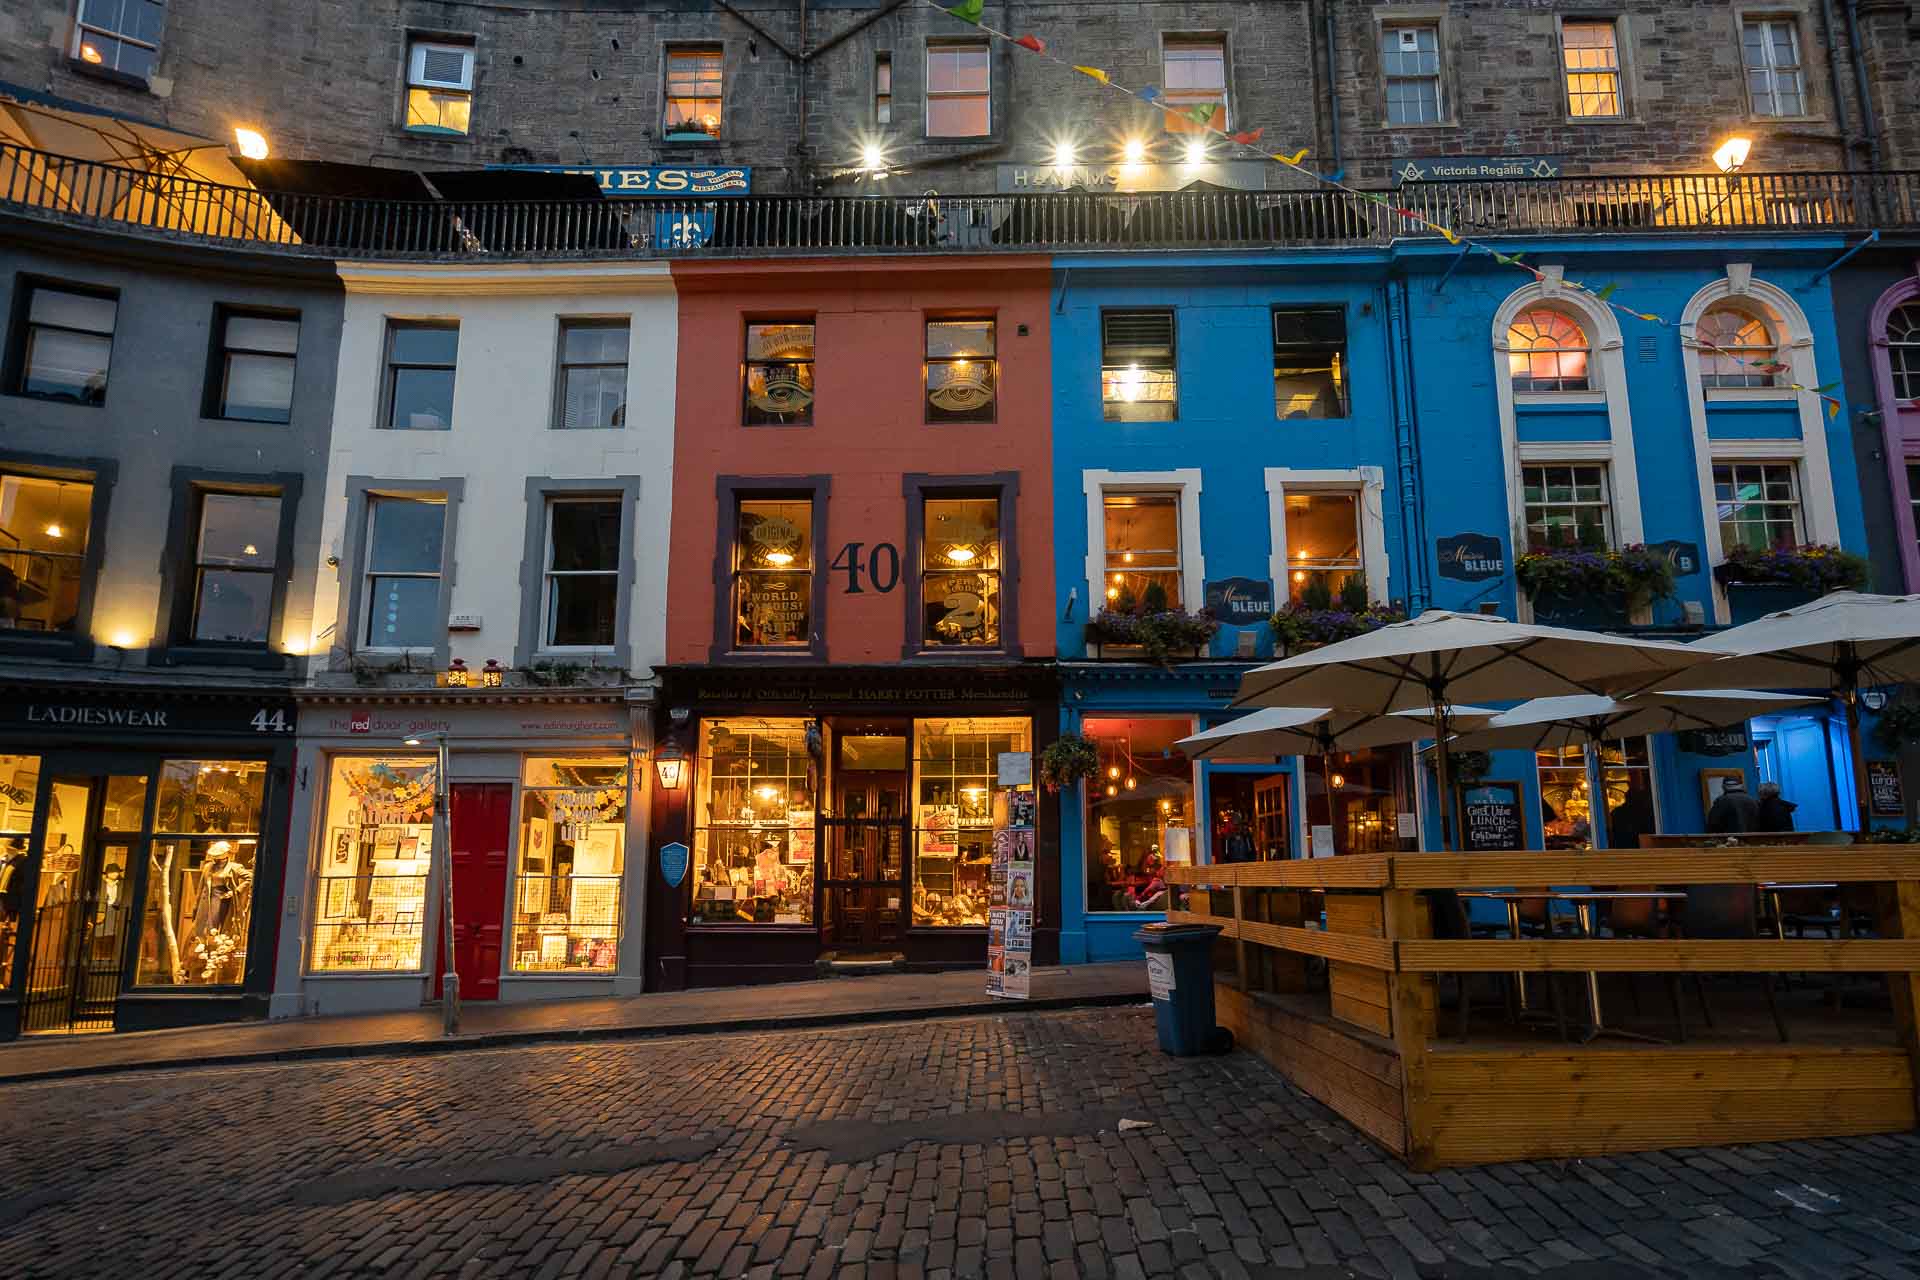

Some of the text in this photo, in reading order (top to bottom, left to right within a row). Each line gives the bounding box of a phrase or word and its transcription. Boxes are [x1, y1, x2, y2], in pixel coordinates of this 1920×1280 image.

[1431, 164, 1524, 177] Victoria Regalia
[831, 542, 900, 594] 40
[1464, 559, 1504, 572] BLEUE
[751, 591, 799, 602] WORLD
[1232, 601, 1270, 613] BLEUE
[858, 688, 901, 699] HARRY
[905, 688, 955, 699] POTTER
[27, 704, 168, 727] LADIESWEAR
[330, 716, 449, 733] the red door gallery
[521, 719, 618, 731] www.edinburghart.com
[661, 766, 676, 780] 40
[1470, 815, 1506, 826] LUNCH
